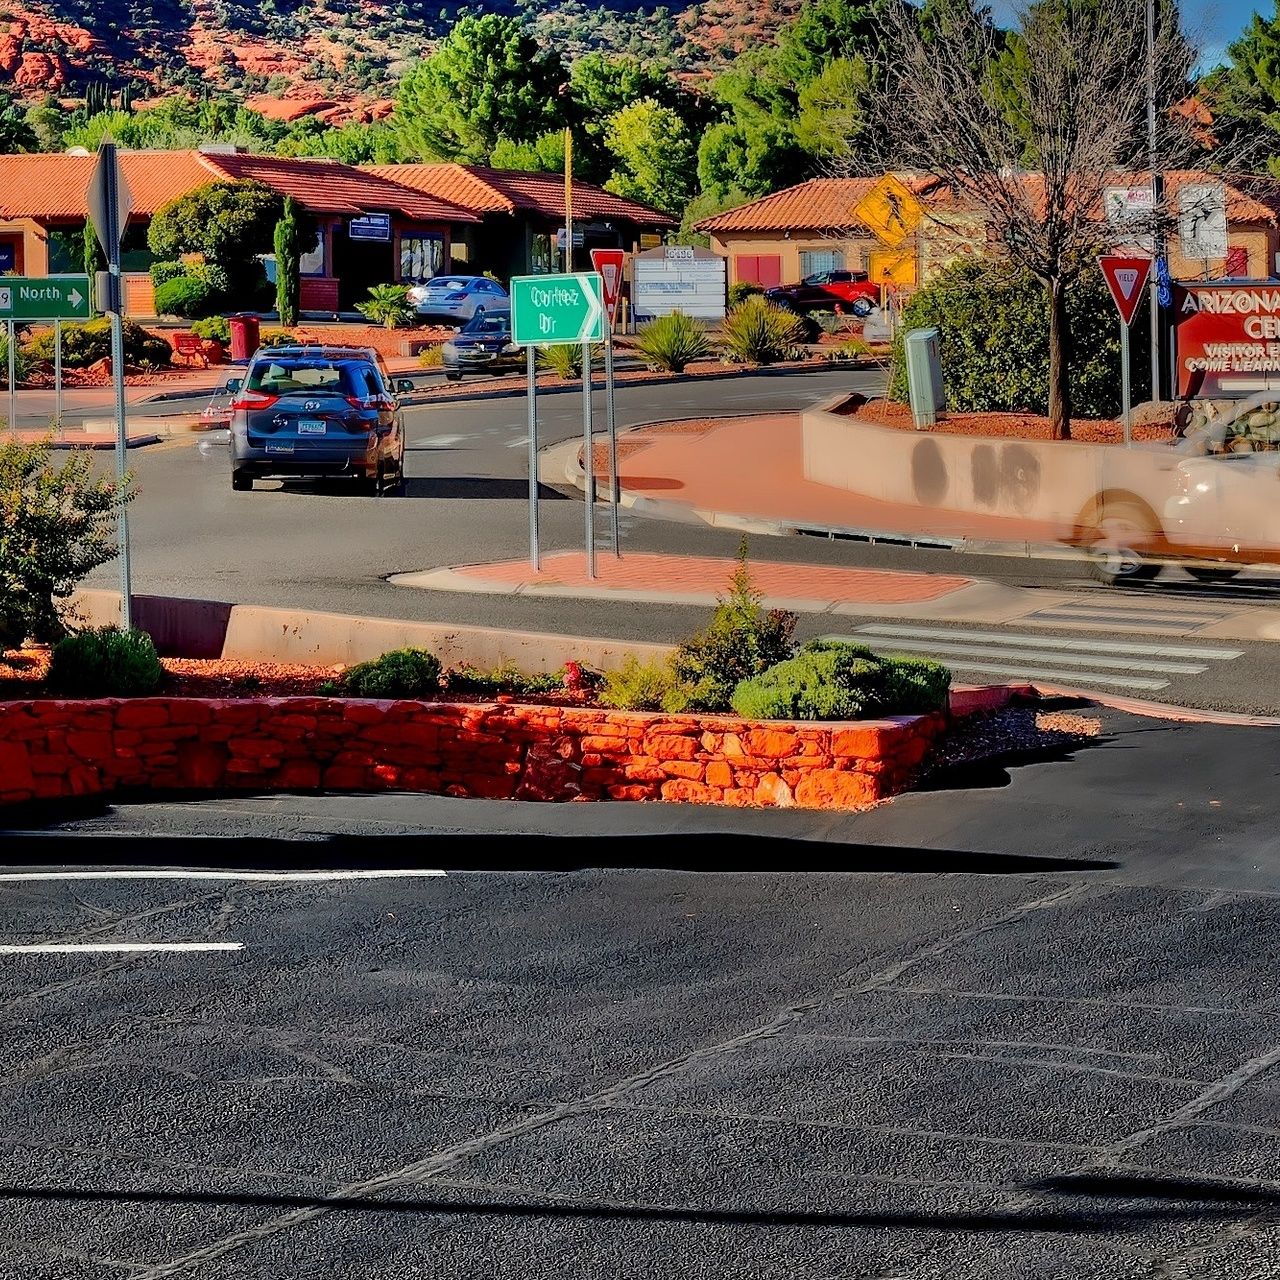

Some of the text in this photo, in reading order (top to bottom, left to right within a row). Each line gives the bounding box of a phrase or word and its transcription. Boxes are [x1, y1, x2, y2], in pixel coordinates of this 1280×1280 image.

[1118, 272, 1135, 282] YIELD
[20, 286, 60, 299] North
[530, 287, 579, 308] Cortez
[539, 313, 556, 334] Dr
[1203, 342, 1266, 358] VISITOR
[1185, 357, 1232, 372] COME
